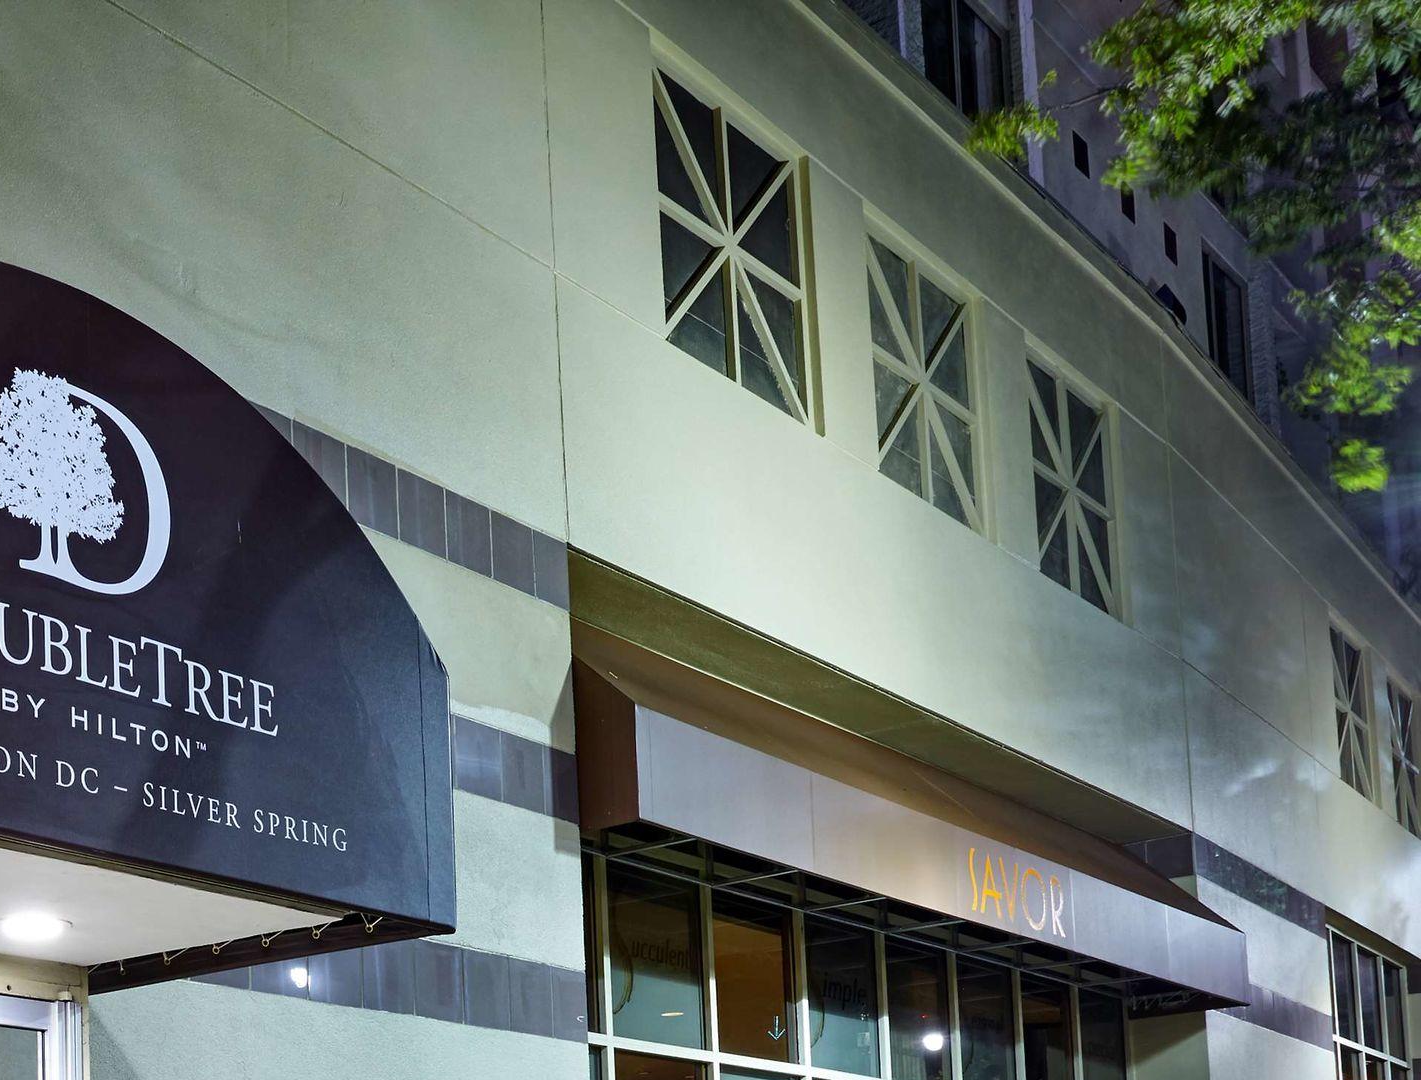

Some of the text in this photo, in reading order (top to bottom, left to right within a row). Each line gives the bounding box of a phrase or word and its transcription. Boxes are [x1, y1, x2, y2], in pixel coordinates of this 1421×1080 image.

[1, 687, 46, 719] BY
[55, 759, 99, 794] DC
[142, 781, 241, 829] SILVER
[253, 808, 348, 852] SPRING
[968, 847, 1066, 938] SAVOR
